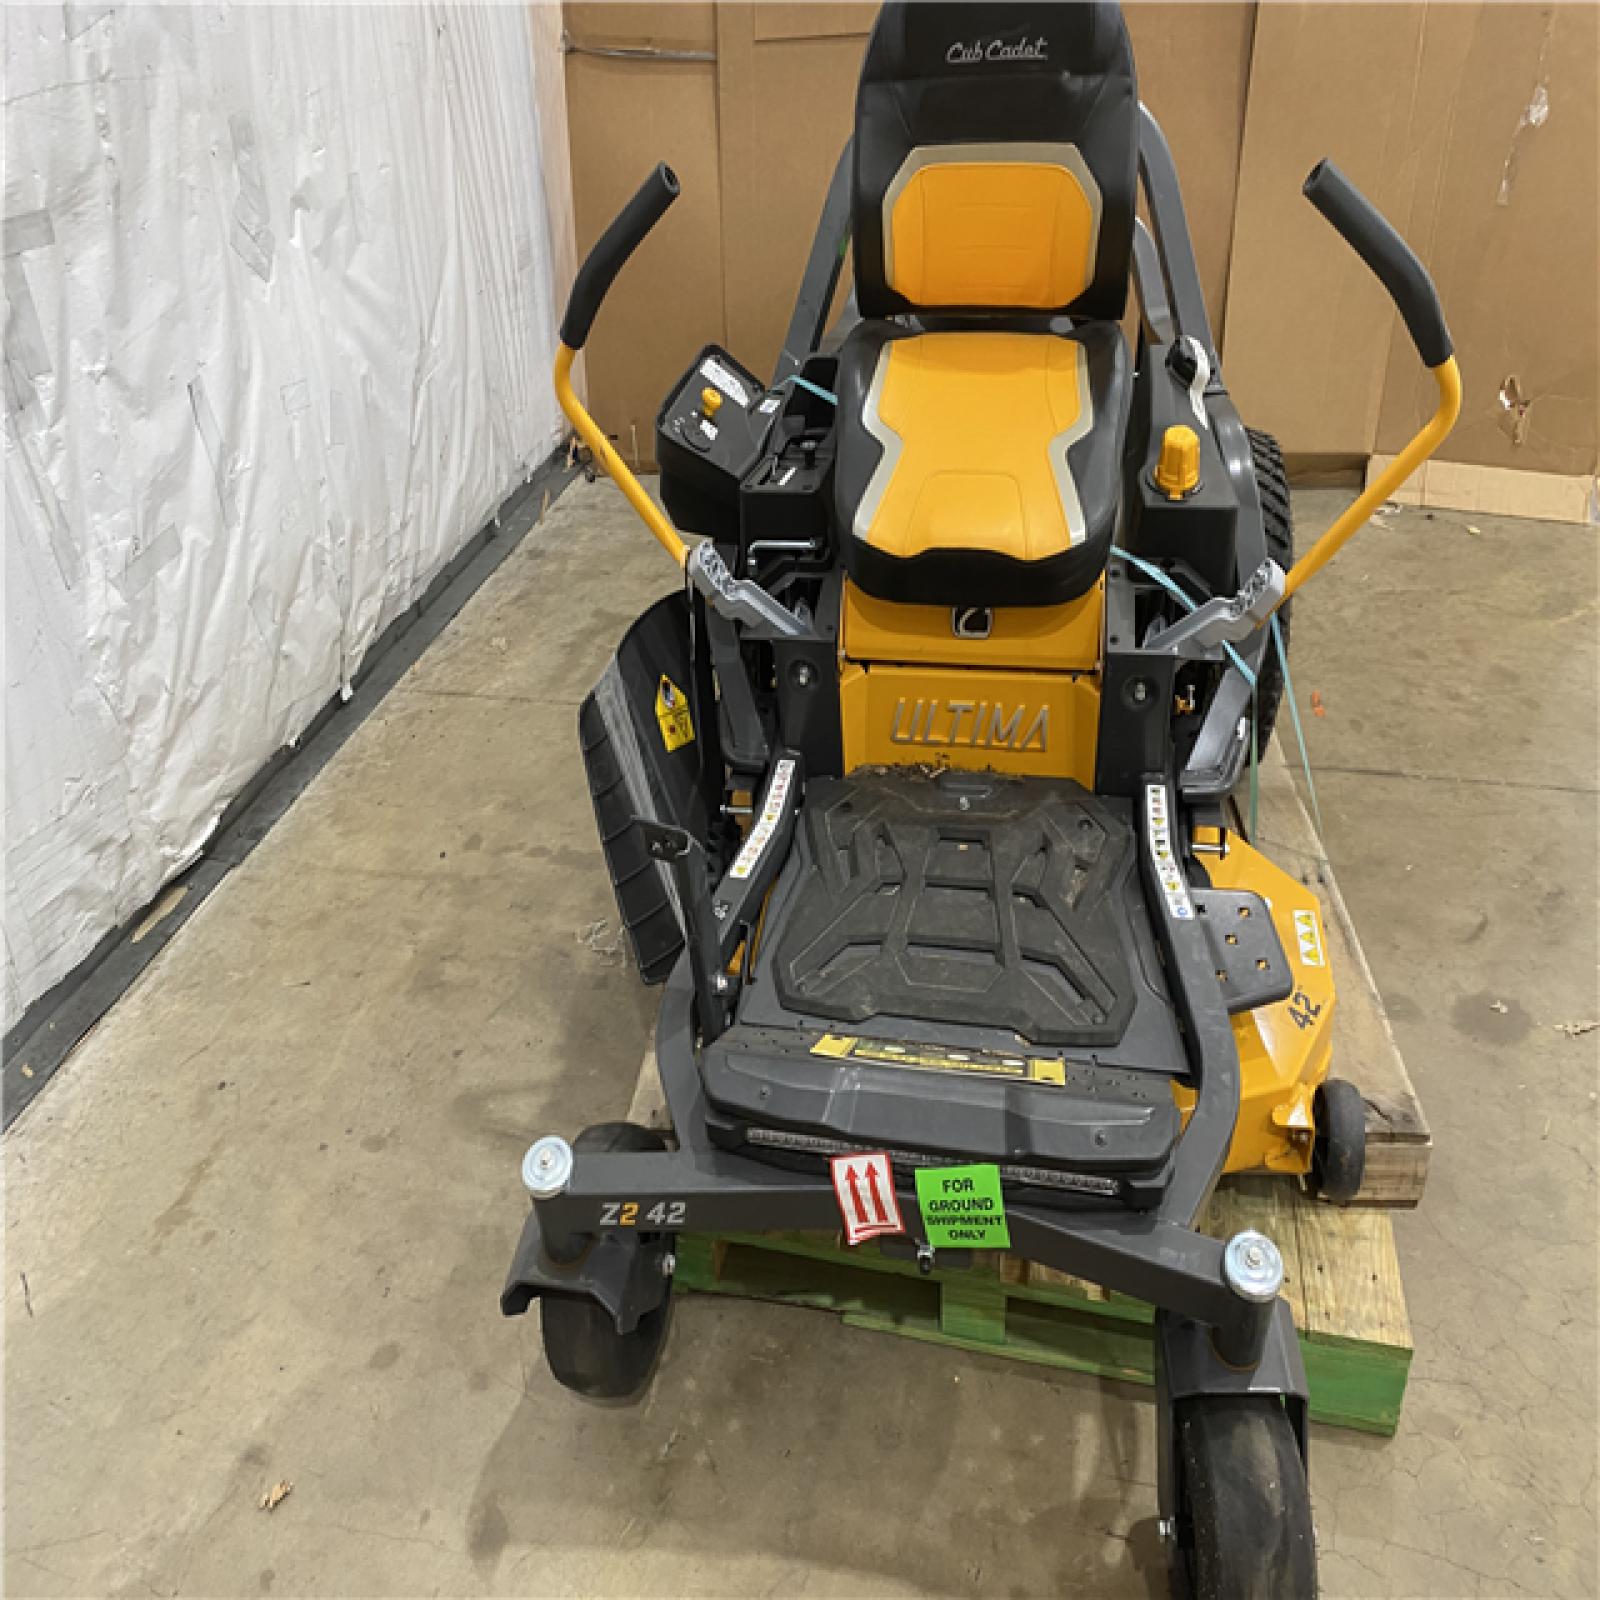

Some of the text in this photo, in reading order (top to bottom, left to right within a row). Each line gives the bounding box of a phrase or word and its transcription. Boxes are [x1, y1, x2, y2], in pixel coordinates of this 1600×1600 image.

[945, 36, 1048, 63] Cub Cadet
[890, 697, 1049, 752] ULTIMA
[1287, 990, 1321, 1030] 42
[942, 1178, 974, 1193] FOR
[599, 1201, 686, 1226] Z2 42
[929, 1197, 994, 1212] GROUND
[926, 1214, 1002, 1226] SHIPMENT
[948, 1229, 986, 1241] ONLY
